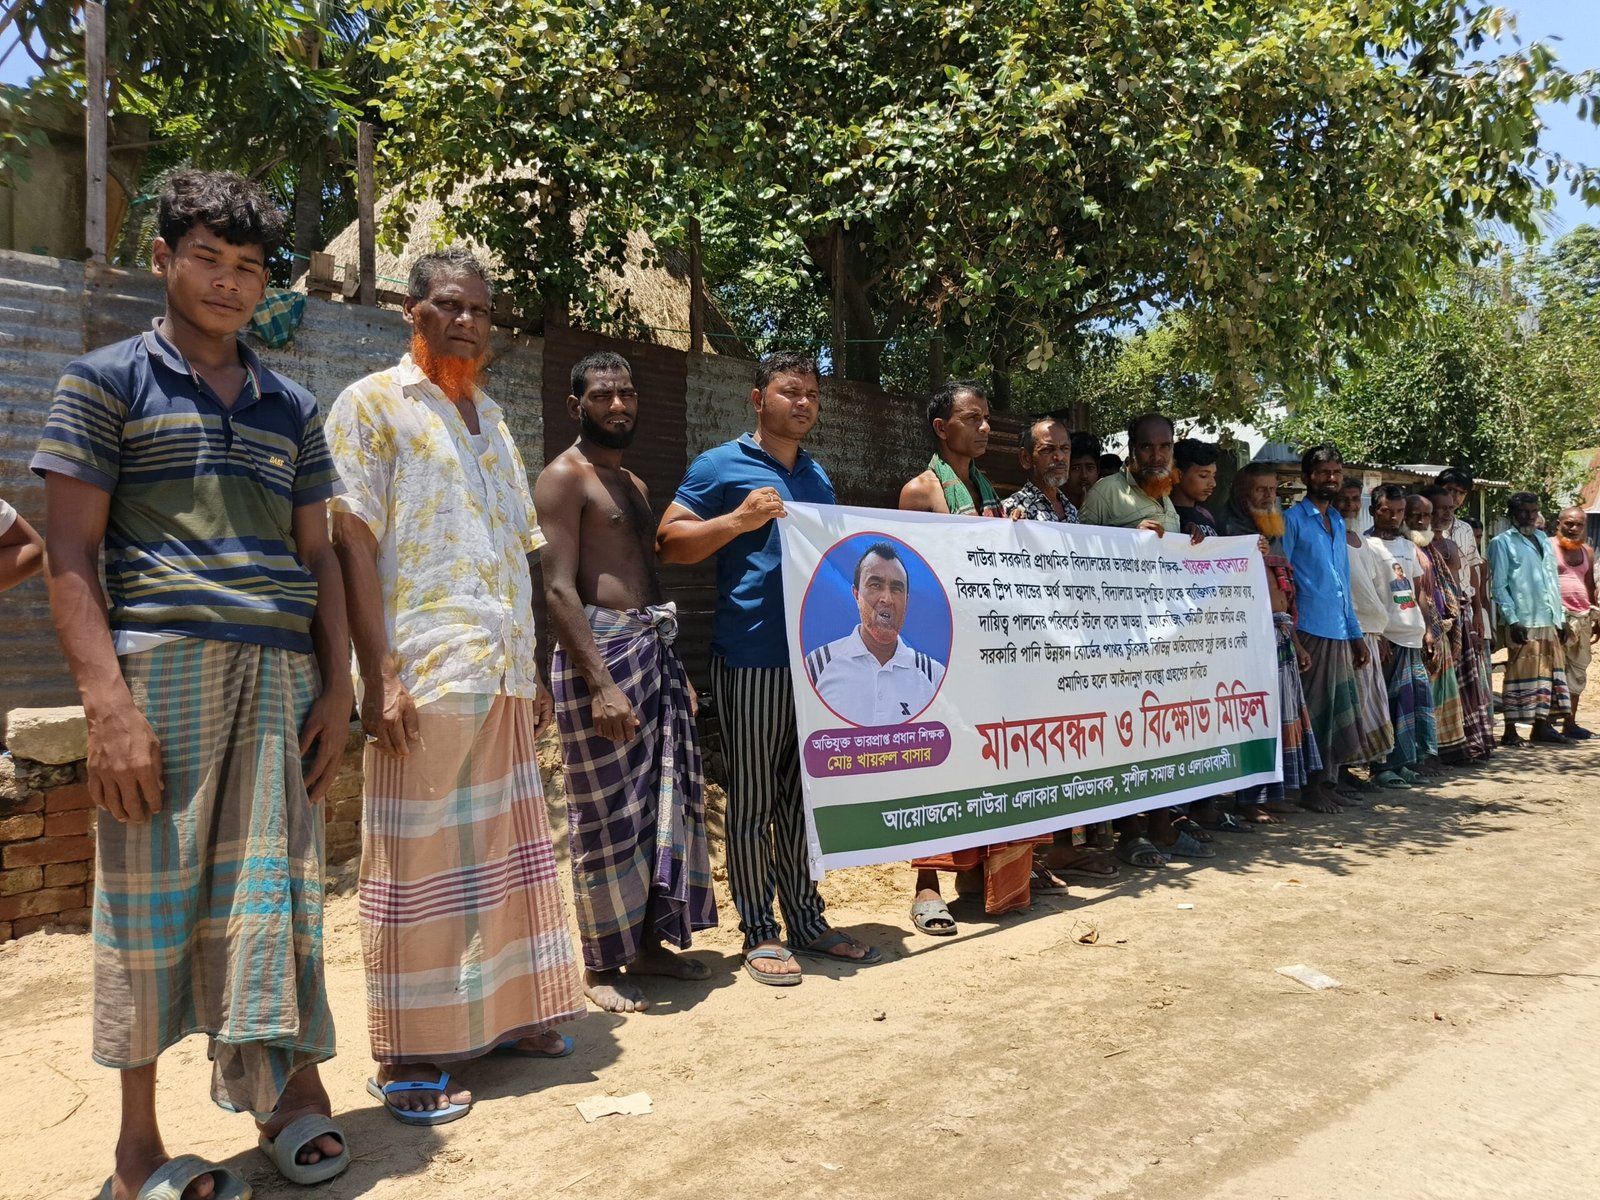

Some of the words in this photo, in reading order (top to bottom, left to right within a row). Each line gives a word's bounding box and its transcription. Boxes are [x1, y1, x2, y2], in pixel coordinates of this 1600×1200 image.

[966, 546, 997, 567] লাউরা
[999, 549, 1031, 569] সরকারি
[1034, 550, 1069, 571] প্রাথমিক
[1070, 551, 1111, 572] বিদ্যালয়ের
[1112, 557, 1139, 573] ভারপ্রাপ্ত
[1141, 558, 1157, 574] প্রধান
[1182, 558, 1216, 575] খায়রুল
[1213, 557, 1249, 574] বাসারের
[955, 577, 991, 600] বিরুদ্ধে
[993, 578, 1012, 600] স্লিপ
[1014, 583, 1041, 600] ফান্ডের
[1043, 579, 1060, 600] অর্থ
[1101, 581, 1134, 601] বিদ্যালয়ে
[1134, 583, 1164, 605] অনুপস্থিত
[1166, 587, 1184, 602] থেকে
[1185, 583, 1217, 600] ব্যক্তিগত
[978, 610, 1009, 636] দায়িত্ব
[1012, 613, 1047, 632] পালনের
[1048, 610, 1079, 631] পরিবর্তে
[1081, 610, 1101, 630] স্টলে
[1103, 615, 1118, 630] বসে
[1183, 607, 1203, 628] কমিটি
[1235, 610, 1247, 624] এবং
[979, 642, 1017, 664] সরকারি
[1020, 641, 1042, 663] পানি
[1044, 641, 1071, 664] উন্নয়ন
[1074, 640, 1101, 660] বোর্ডের
[1103, 642, 1124, 659] পাথর
[1123, 638, 1149, 662] চুরিসহ
[1150, 637, 1171, 657] বিভিন্ন
[1172, 635, 1204, 655] অভিযোগের
[1228, 637, 1233, 649] ও
[1234, 631, 1248, 650] দোষী
[1057, 670, 1089, 692] প্রমাণিত
[1091, 674, 1107, 689] হলে
[1110, 667, 1143, 690] আইনানুগ
[1144, 668, 1165, 687] ব্যবস্থা
[1166, 665, 1188, 683] গ্রহণের
[1190, 661, 1208, 680] দাবিতে
[975, 711, 1107, 770] মানববন্ধন
[1114, 710, 1133, 748] ও
[1139, 690, 1211, 748] বিক্ষোভ
[1214, 679, 1270, 735] মিছিল
[812, 734, 851, 752] অভিযুক্ত
[854, 734, 890, 748] ভারপ্রাপ্ত
[892, 731, 916, 744] প্রধান
[918, 727, 945, 743] শিক্ষক
[827, 754, 853, 771] মোঃ
[857, 751, 898, 768] খায়রুল
[901, 747, 932, 764] বাসার
[966, 791, 1008, 818] লাউরা
[1012, 784, 1058, 810] এলাকার
[1061, 775, 1119, 800] অভিভাবক,
[1121, 764, 1149, 793] সুশীল
[1150, 763, 1176, 784] সমাজ
[1178, 763, 1186, 777] ও
